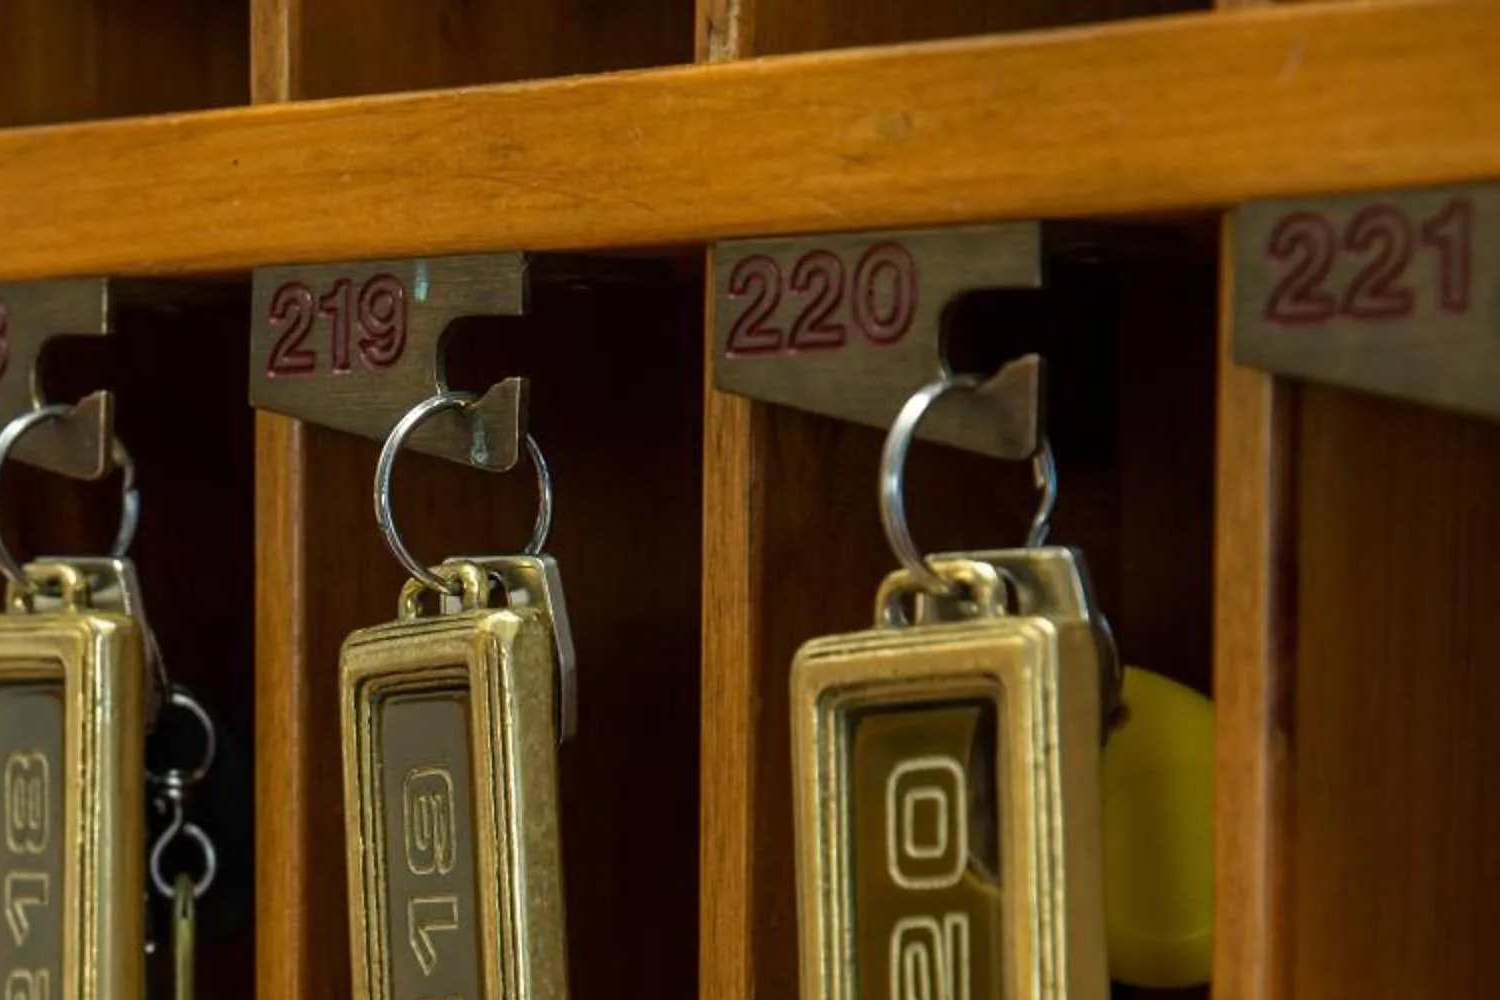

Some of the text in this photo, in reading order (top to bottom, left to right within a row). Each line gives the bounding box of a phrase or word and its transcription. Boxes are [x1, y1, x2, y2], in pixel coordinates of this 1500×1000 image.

[726, 241, 919, 359] 220
[1264, 196, 1478, 328] 221
[266, 272, 409, 379] 219
